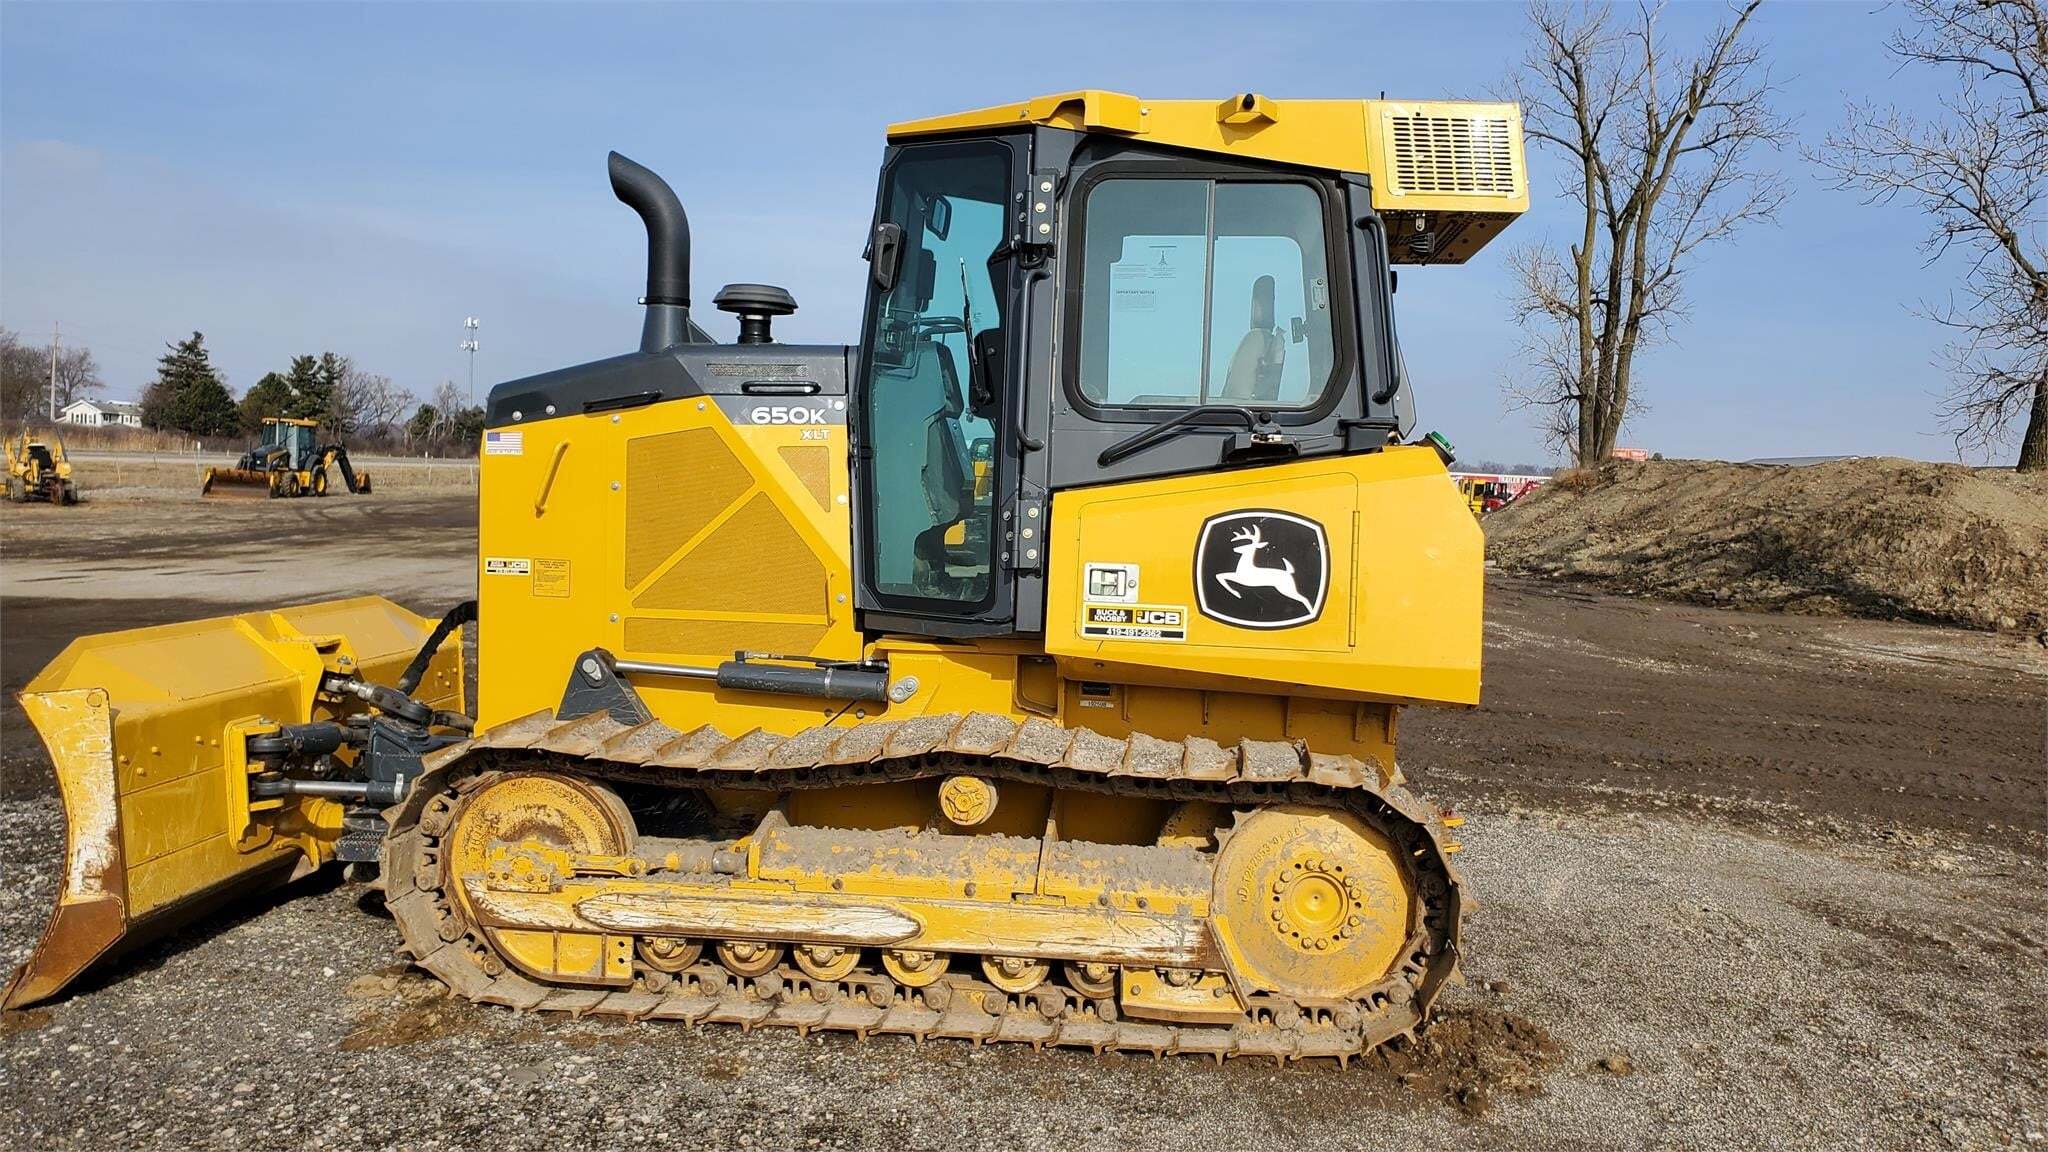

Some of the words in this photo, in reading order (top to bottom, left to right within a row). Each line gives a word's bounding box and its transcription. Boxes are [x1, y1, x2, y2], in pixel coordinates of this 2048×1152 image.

[751, 406, 827, 425] 650K
[800, 429, 831, 440] XLT
[1136, 611, 1181, 625] JCB
